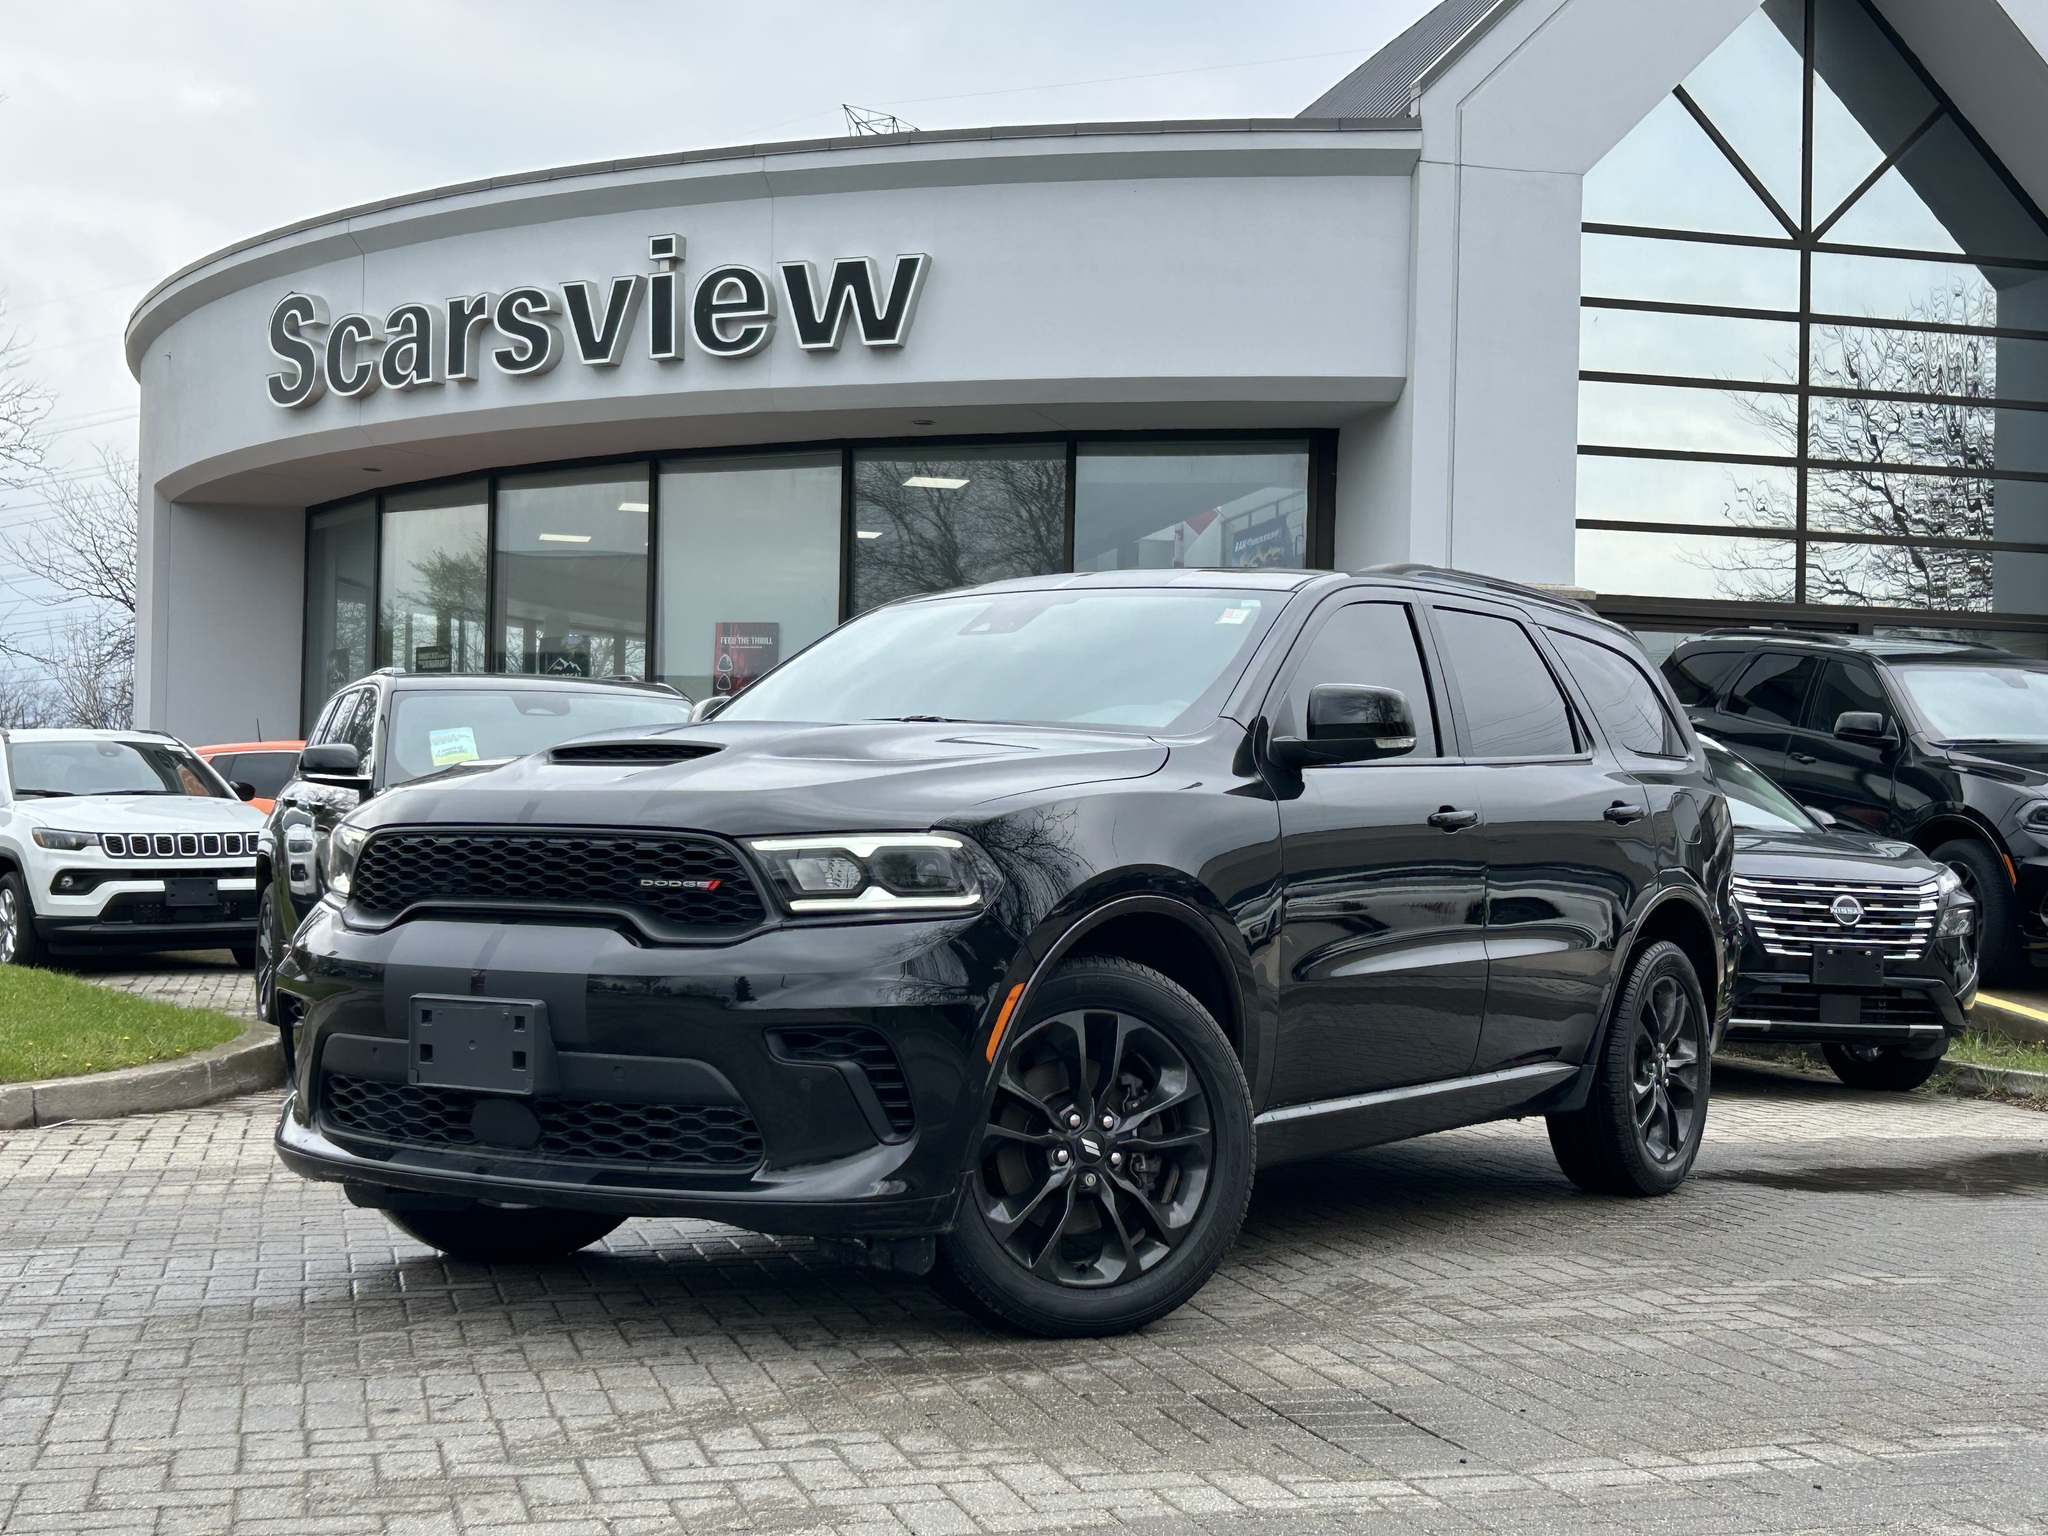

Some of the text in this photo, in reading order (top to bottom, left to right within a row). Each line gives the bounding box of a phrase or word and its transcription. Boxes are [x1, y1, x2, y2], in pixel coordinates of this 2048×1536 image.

[267, 233, 932, 409] Scarsview
[738, 636, 750, 645] THE
[751, 636, 773, 645] THRILL
[640, 879, 710, 888] DODGE
